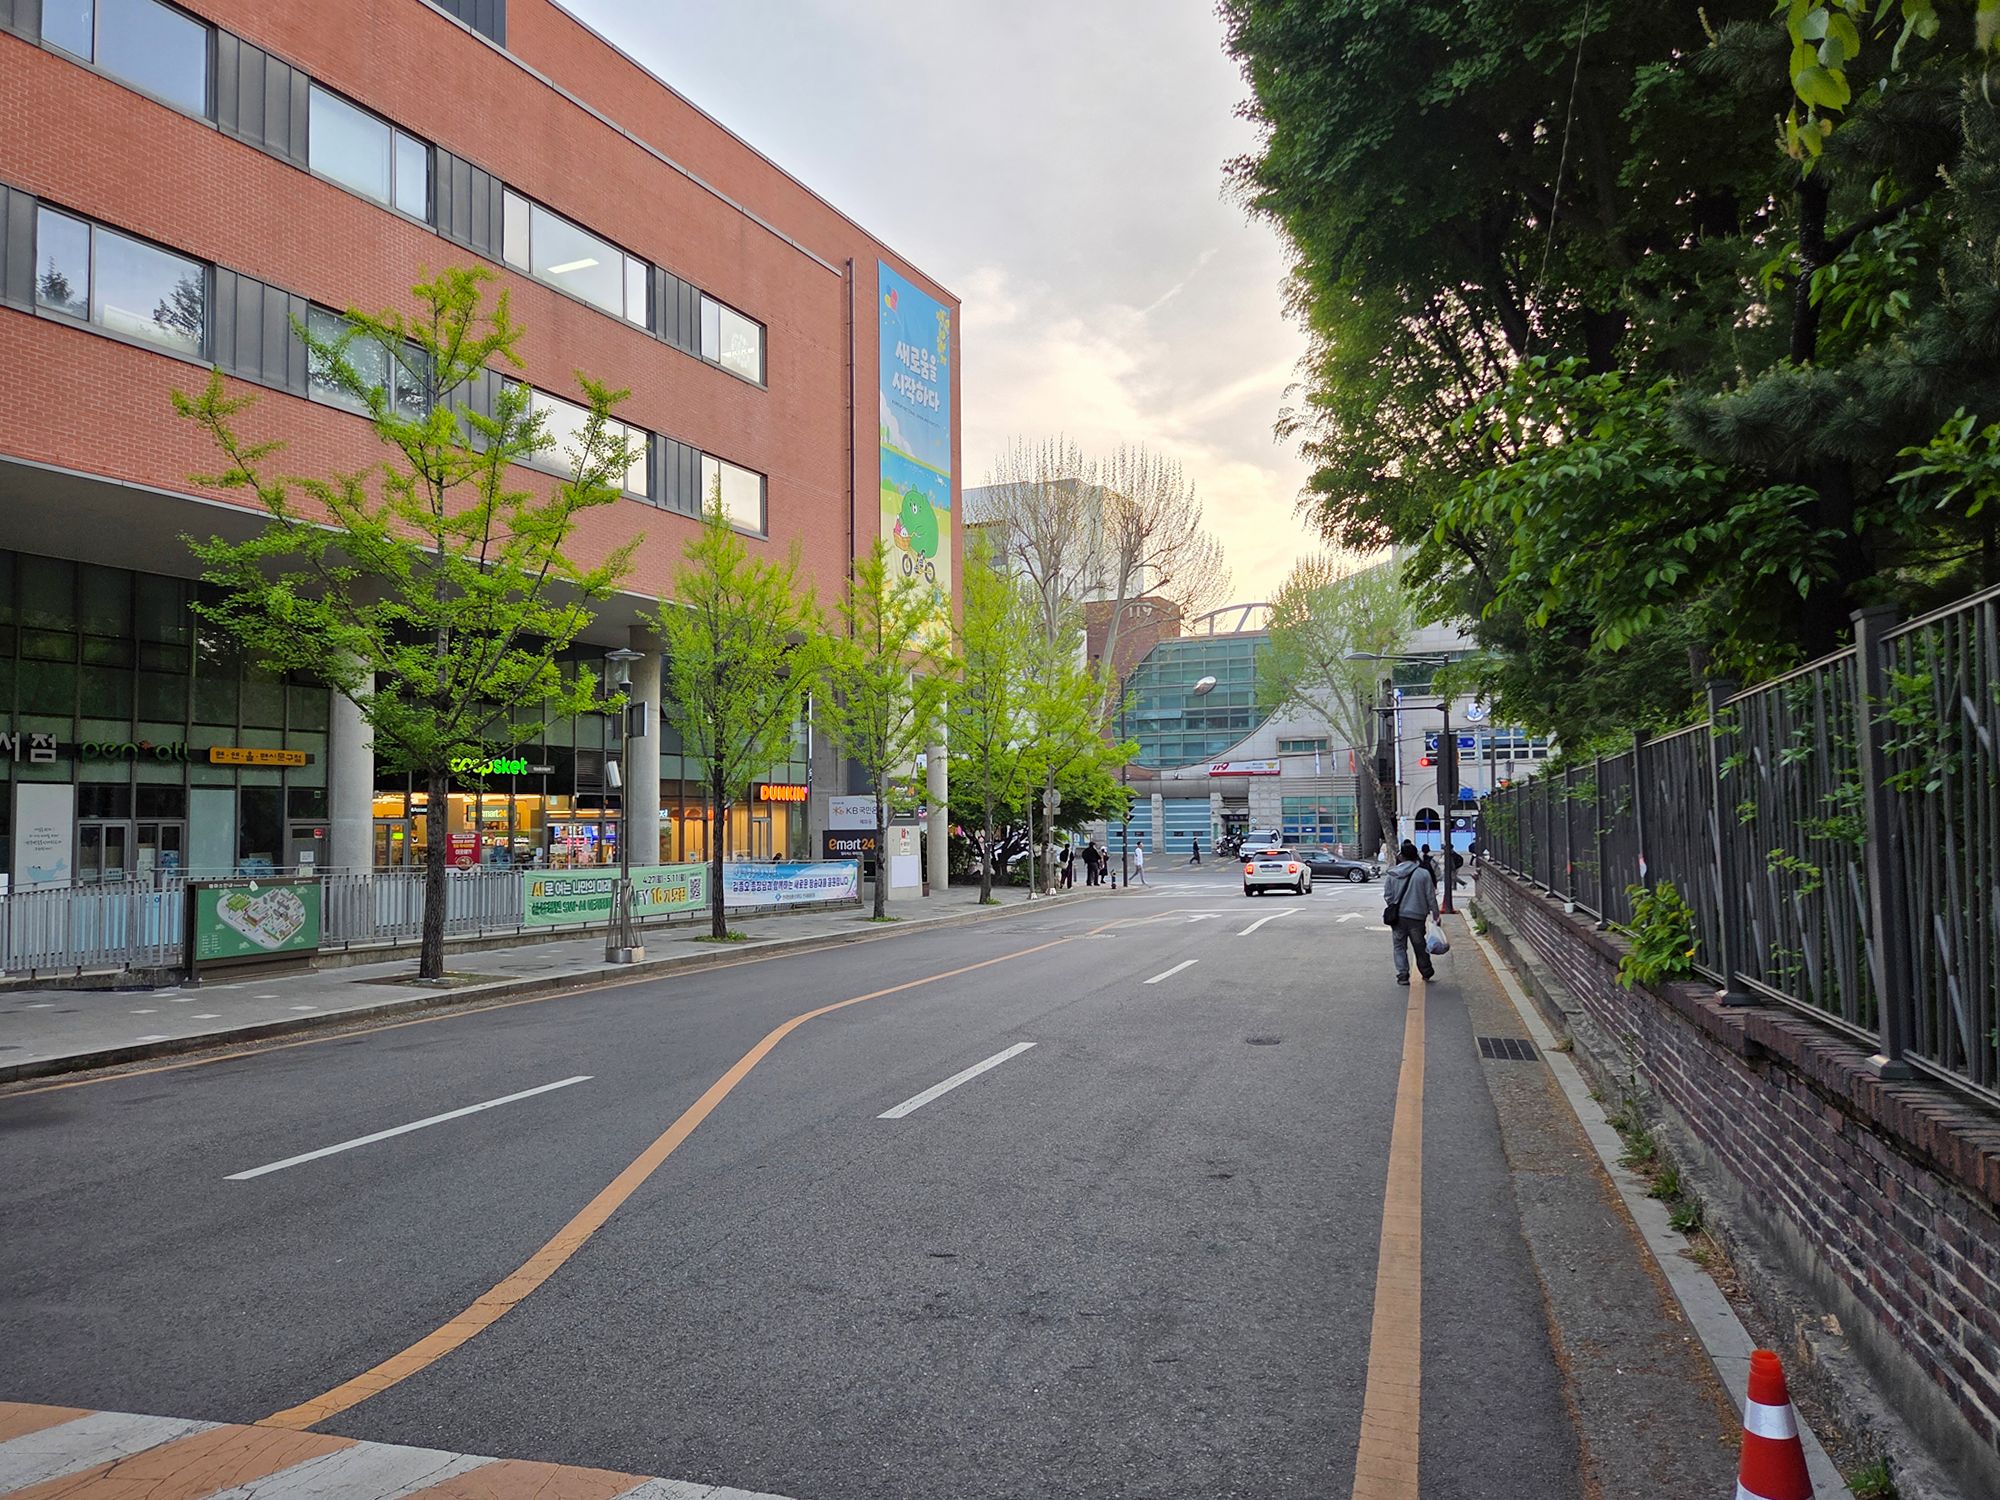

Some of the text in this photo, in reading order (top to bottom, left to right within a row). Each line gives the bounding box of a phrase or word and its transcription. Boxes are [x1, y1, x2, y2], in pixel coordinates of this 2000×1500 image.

[895, 341, 937, 383] 새로움을
[892, 372, 940, 412] 시작하다
[1212, 762, 1229, 770] 119
[846, 806, 877, 815] KB국민은
[828, 838, 875, 851] emart24
[555, 880, 572, 897] 여는
[573, 878, 596, 895] 나만의
